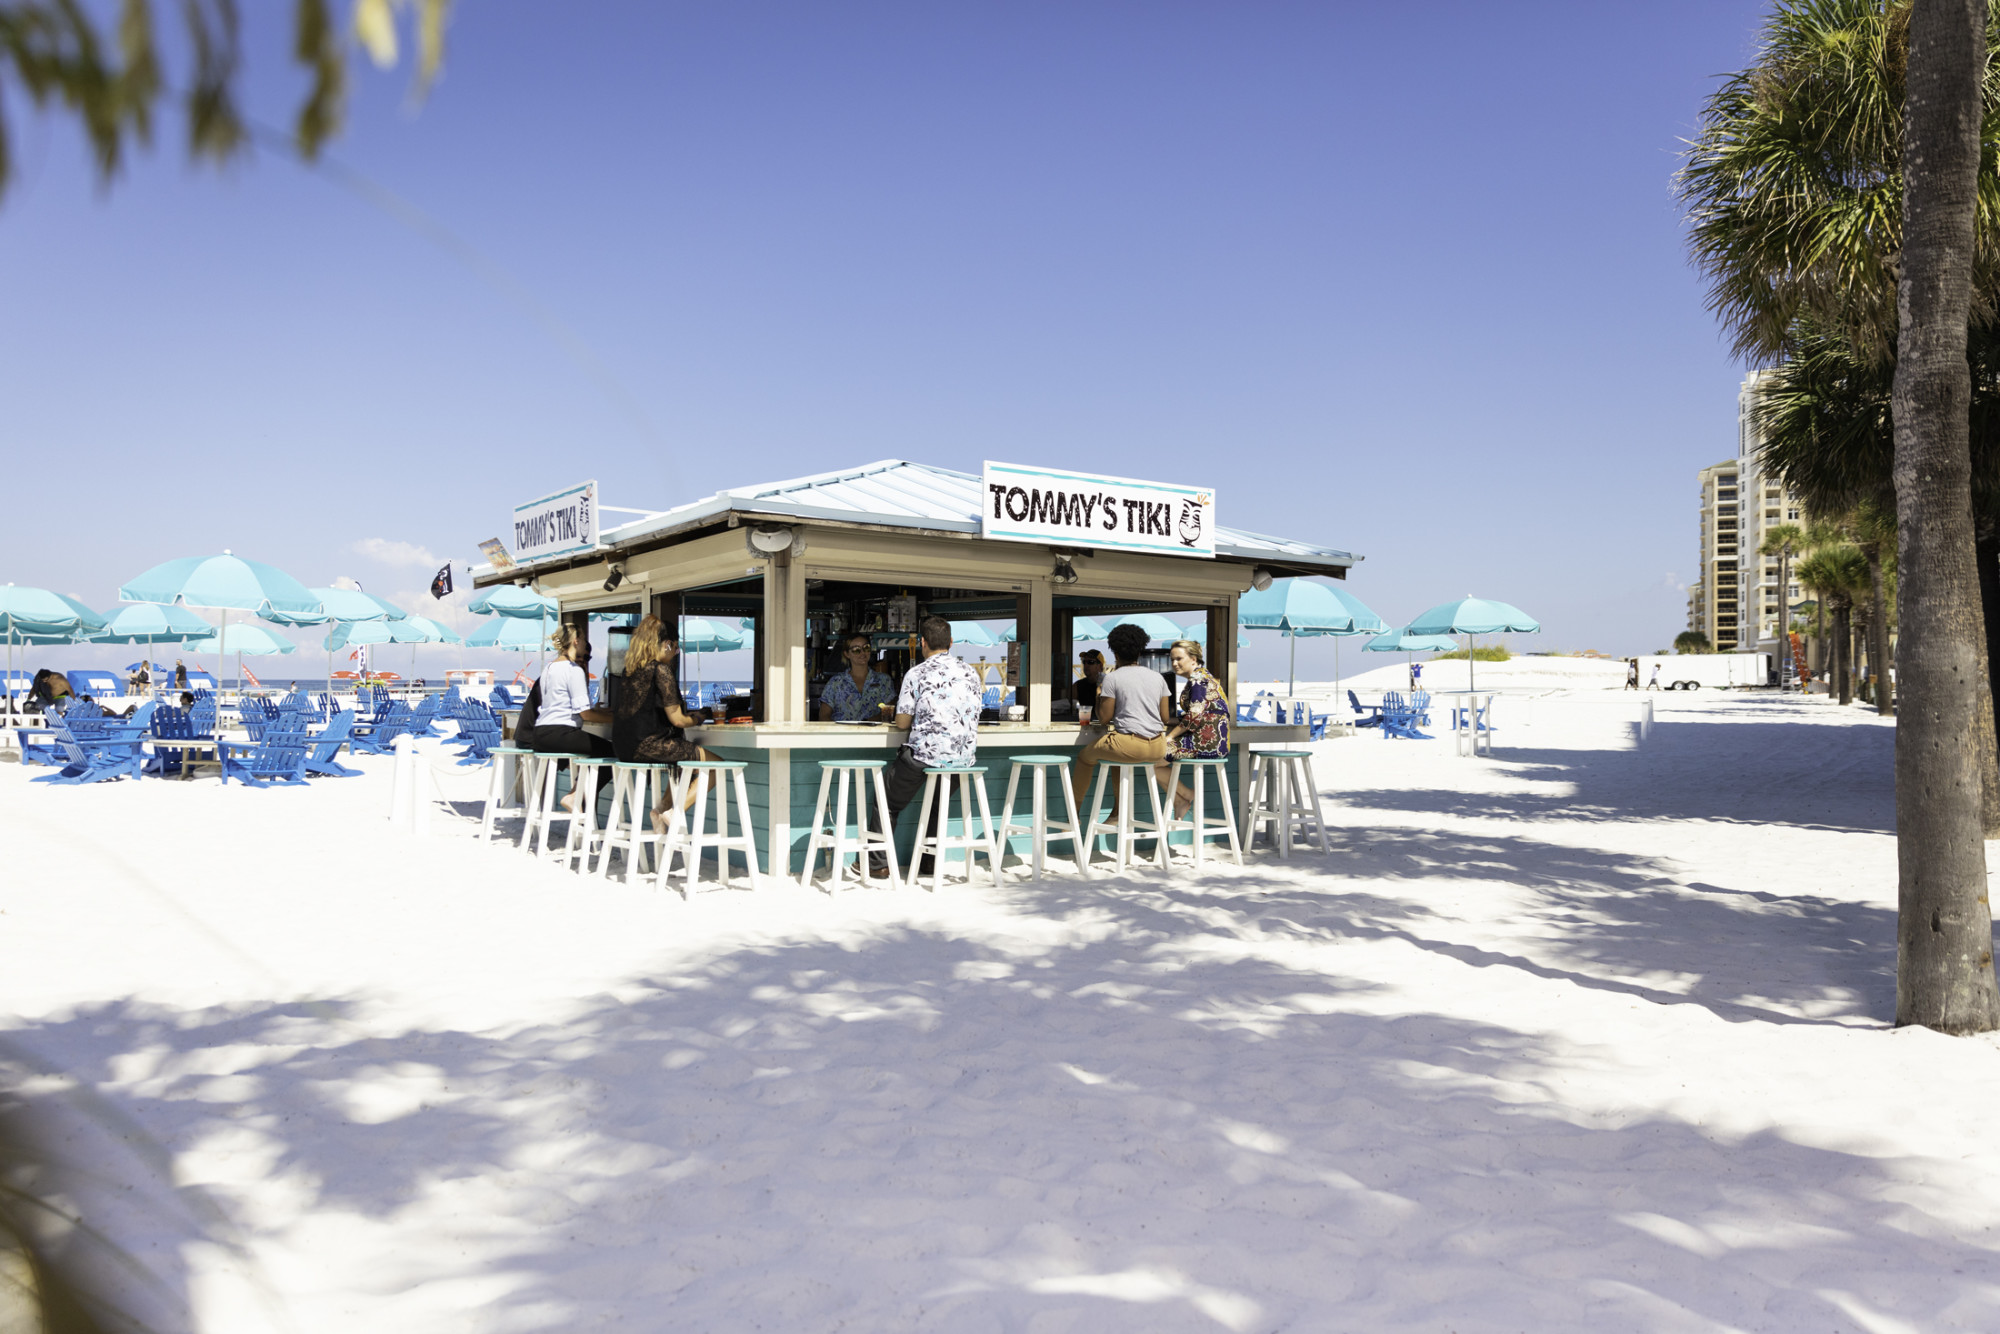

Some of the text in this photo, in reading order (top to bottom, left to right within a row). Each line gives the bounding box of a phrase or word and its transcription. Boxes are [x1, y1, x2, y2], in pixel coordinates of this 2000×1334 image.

[515, 505, 577, 550] TOMMY'S TIKI
[989, 483, 1171, 536] TOMMY'S TIKI
